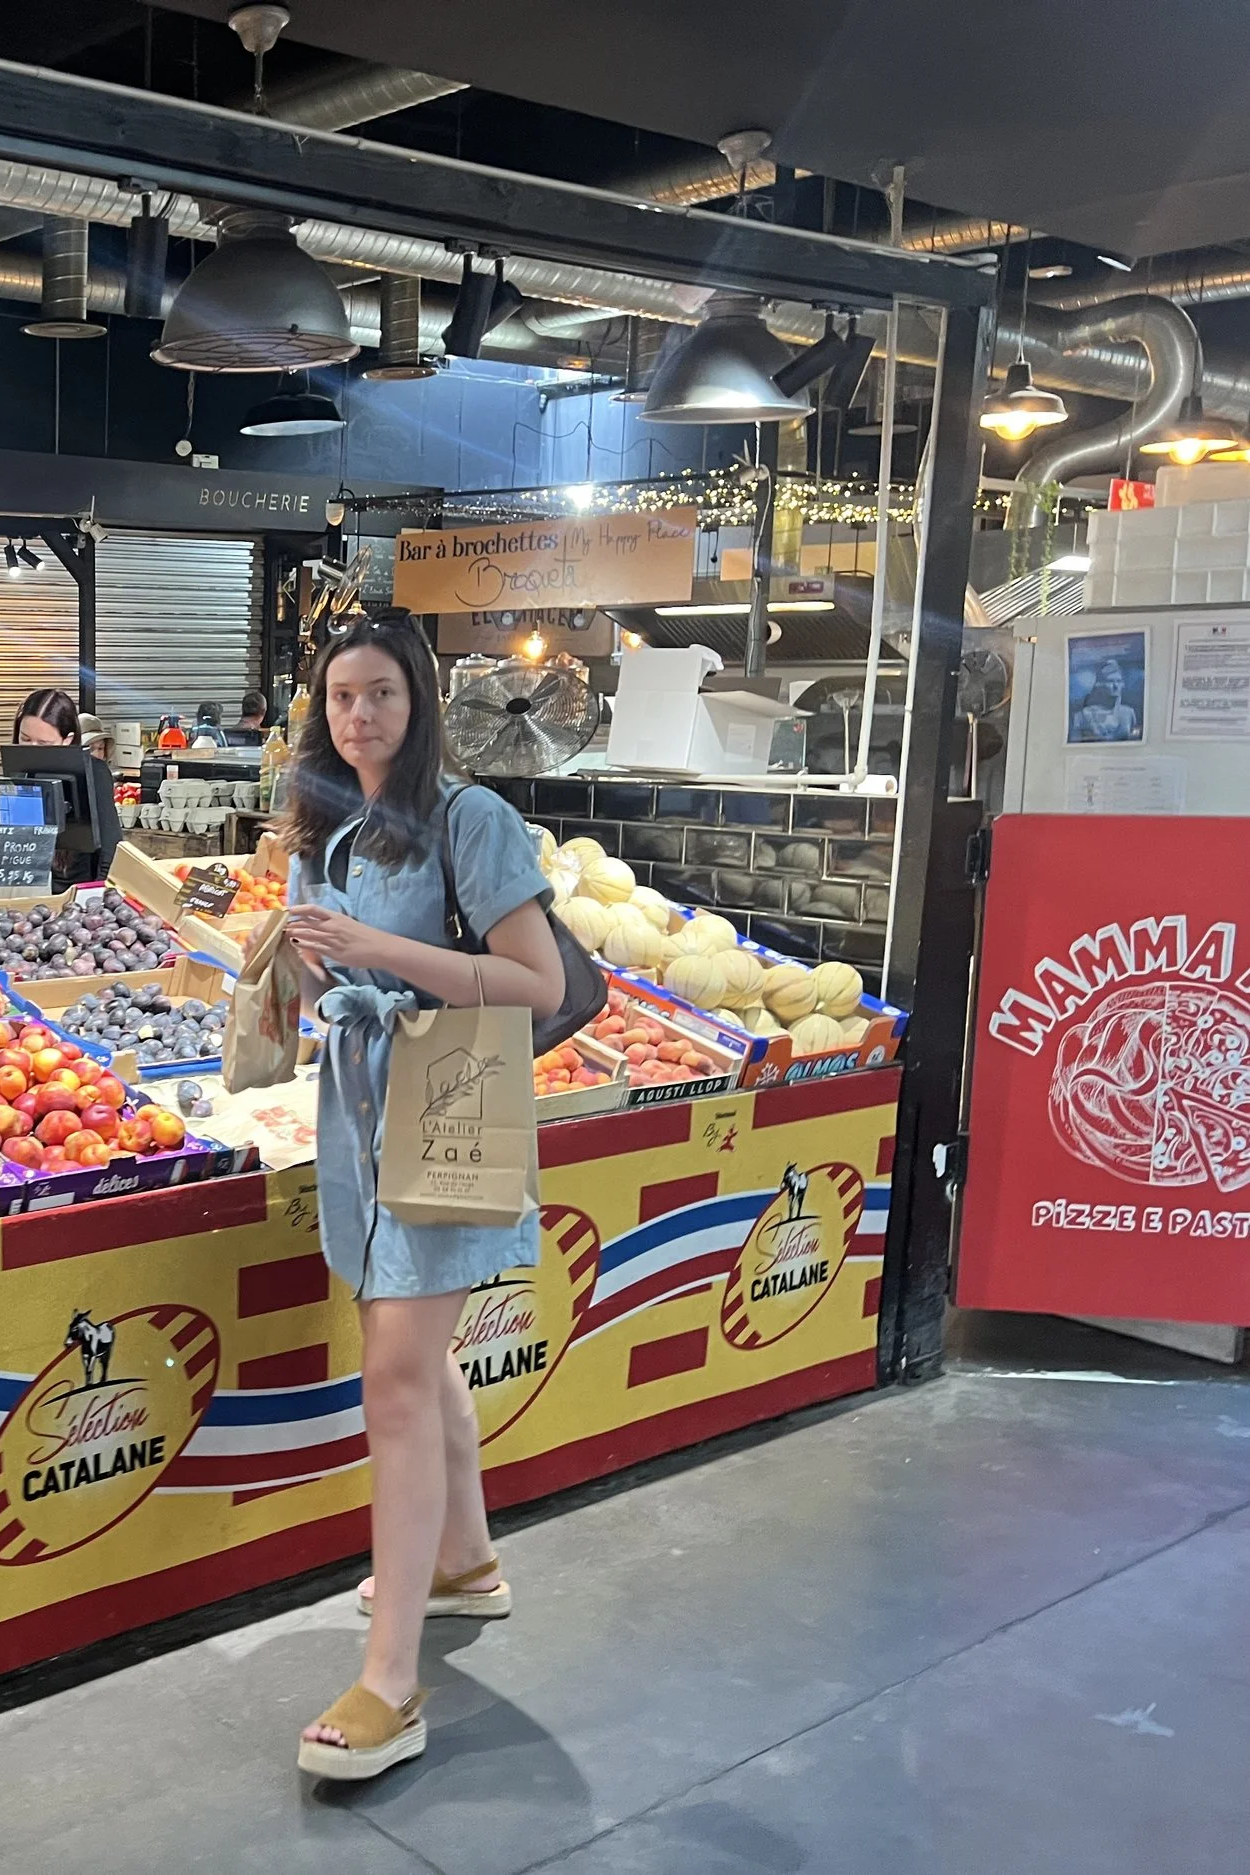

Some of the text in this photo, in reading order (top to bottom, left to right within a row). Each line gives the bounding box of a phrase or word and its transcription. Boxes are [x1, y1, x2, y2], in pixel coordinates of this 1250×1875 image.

[199, 487, 310, 512] BOUCHERIE
[399, 531, 558, 562] Bar à brochettes
[3, 841, 37, 853] PROMO
[989, 914, 1236, 1057] MAMMA
[690, 1079, 723, 1096] LLOP
[422, 1120, 484, 1137] L'Atelier
[421, 1139, 483, 1164] Zaé
[93, 1173, 140, 1196] délices
[426, 1170, 480, 1182] PERPIGNAN
[1141, 1207, 1163, 1234] E
[754, 1212, 822, 1276] Sélection
[750, 1259, 830, 1302] CATALANE
[451, 1289, 537, 1354] élection
[26, 1380, 152, 1465] Sélection
[22, 1435, 166, 1502] CATALANE
